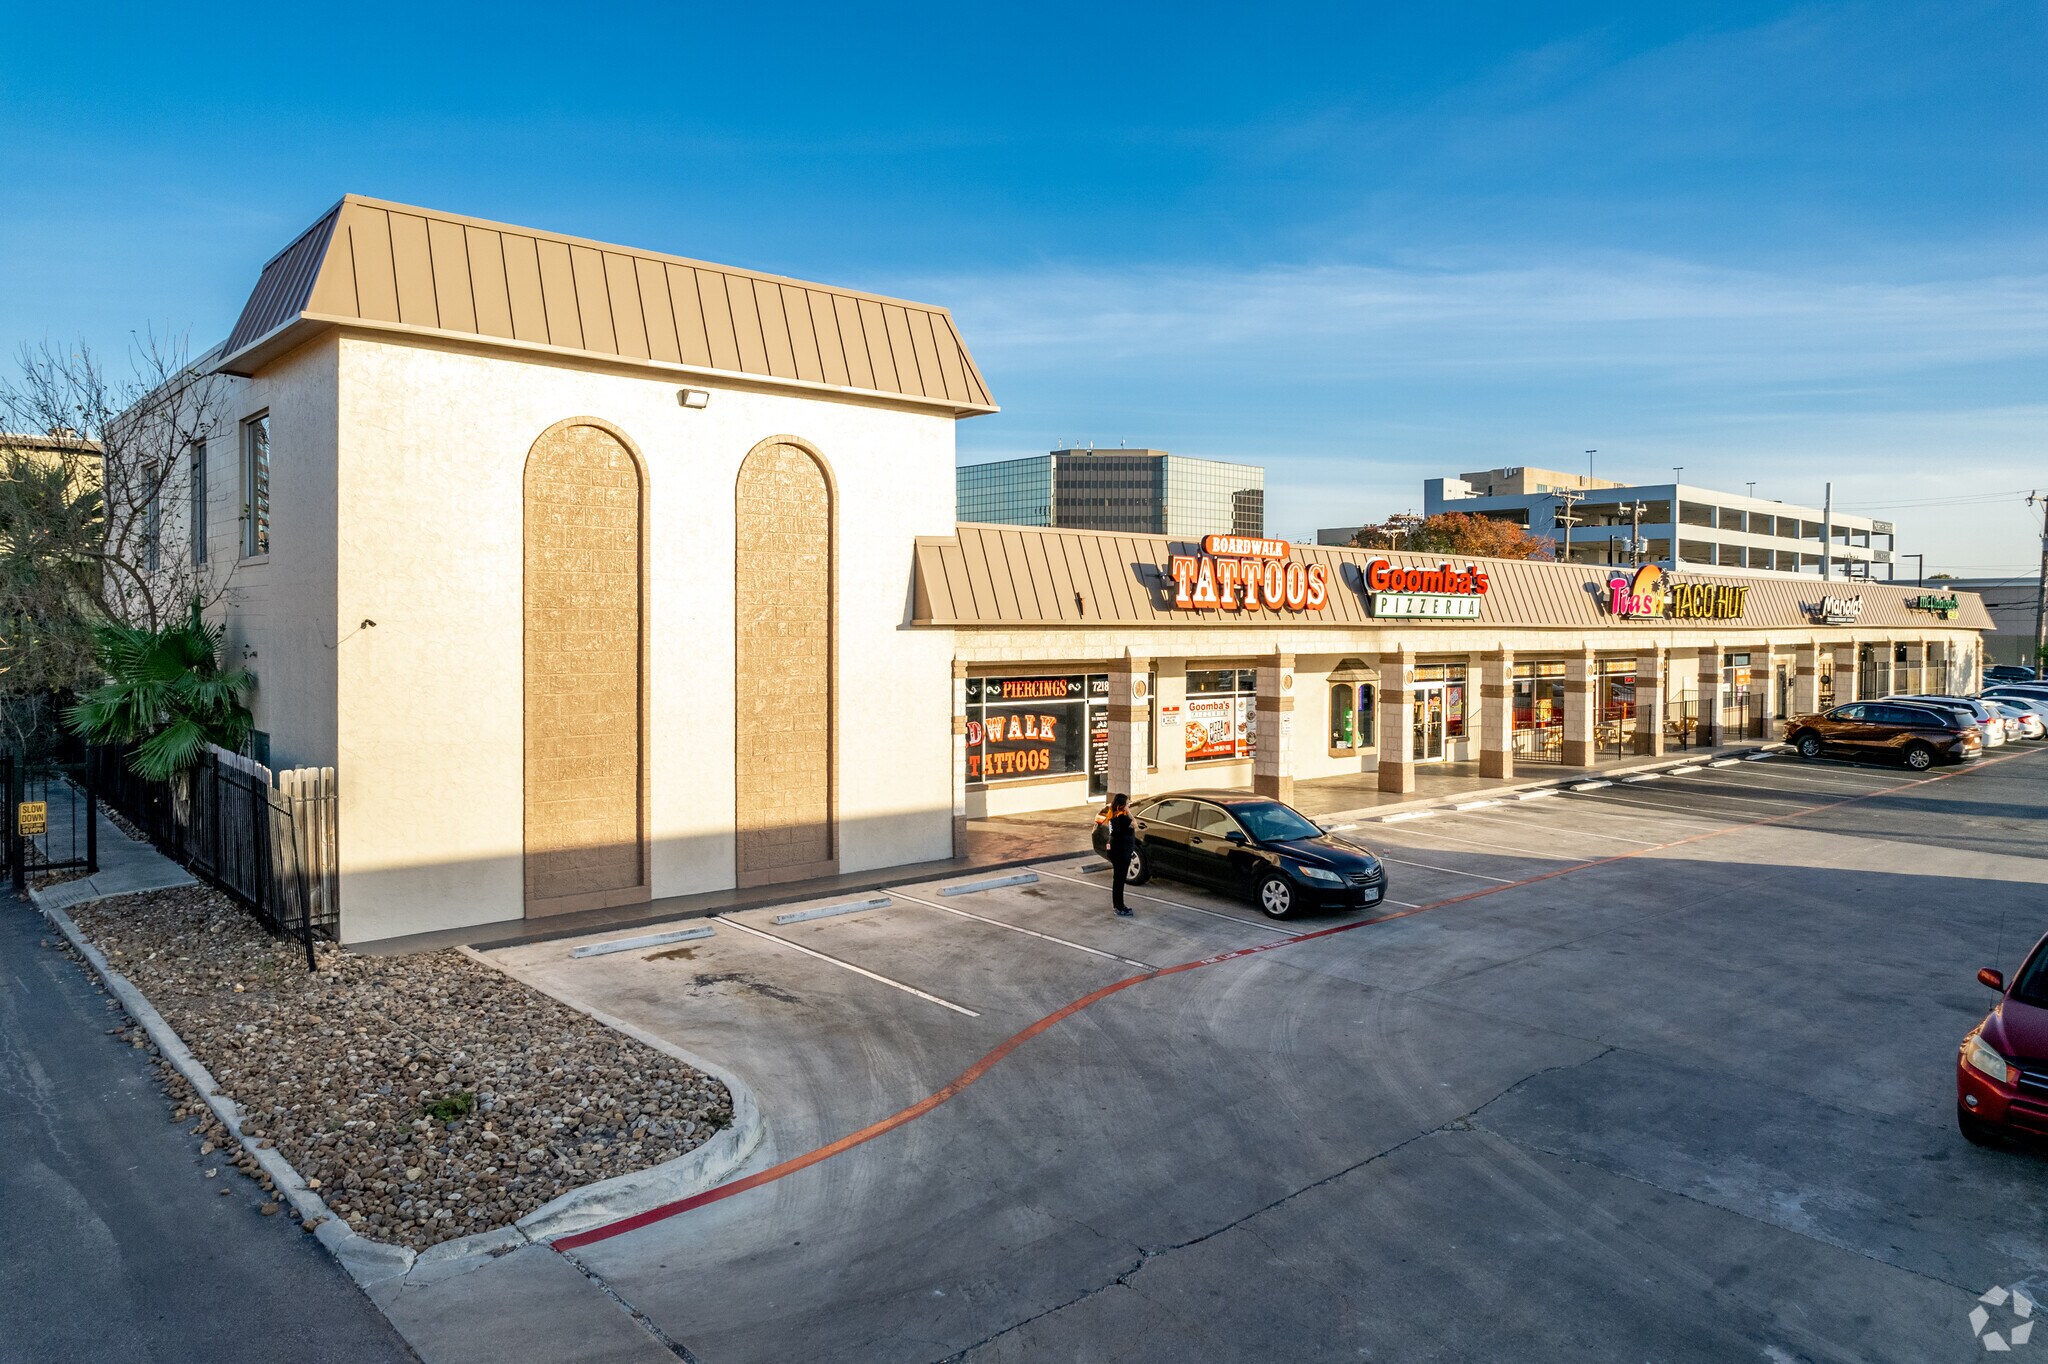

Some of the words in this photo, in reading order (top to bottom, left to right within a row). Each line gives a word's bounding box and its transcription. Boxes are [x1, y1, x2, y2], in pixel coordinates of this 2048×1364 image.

[1212, 537, 1284, 557] BOARDWALK
[1171, 555, 1327, 608] TATTOOS
[1369, 558, 1489, 596] Goomba's
[1380, 597, 1475, 615] PIZZERIA
[1610, 577, 1653, 615] Tia's
[1673, 583, 1715, 618] TACO
[1717, 585, 1749, 618] HUT
[1003, 679, 1067, 698] PIERCINGS
[1092, 681, 1109, 692] 7218
[1189, 701, 1230, 711] Goomba's
[965, 714, 1057, 748] DWALK
[969, 748, 1050, 776] TATTOOS
[22, 805, 43, 814] SLOW
[22, 814, 44, 822] DOWN
